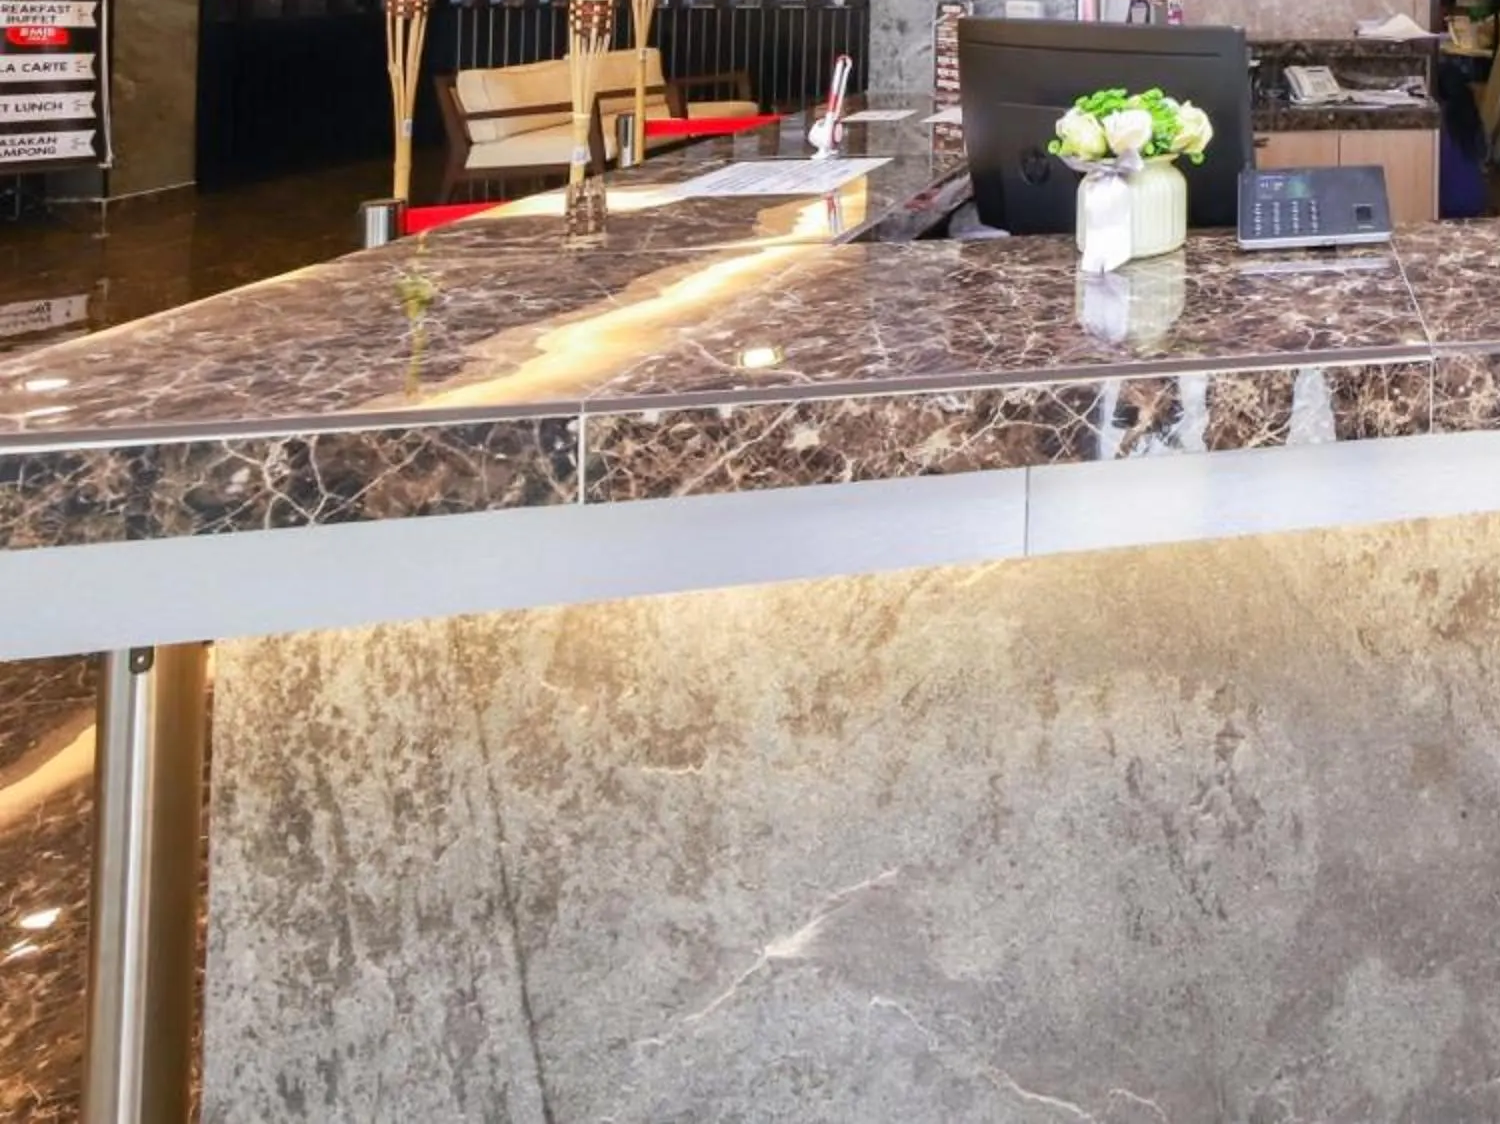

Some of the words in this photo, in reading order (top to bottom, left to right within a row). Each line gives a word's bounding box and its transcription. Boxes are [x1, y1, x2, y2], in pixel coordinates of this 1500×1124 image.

[0, 63, 16, 73] A
[21, 61, 68, 73] CARTE
[14, 100, 64, 113] LUNCH
